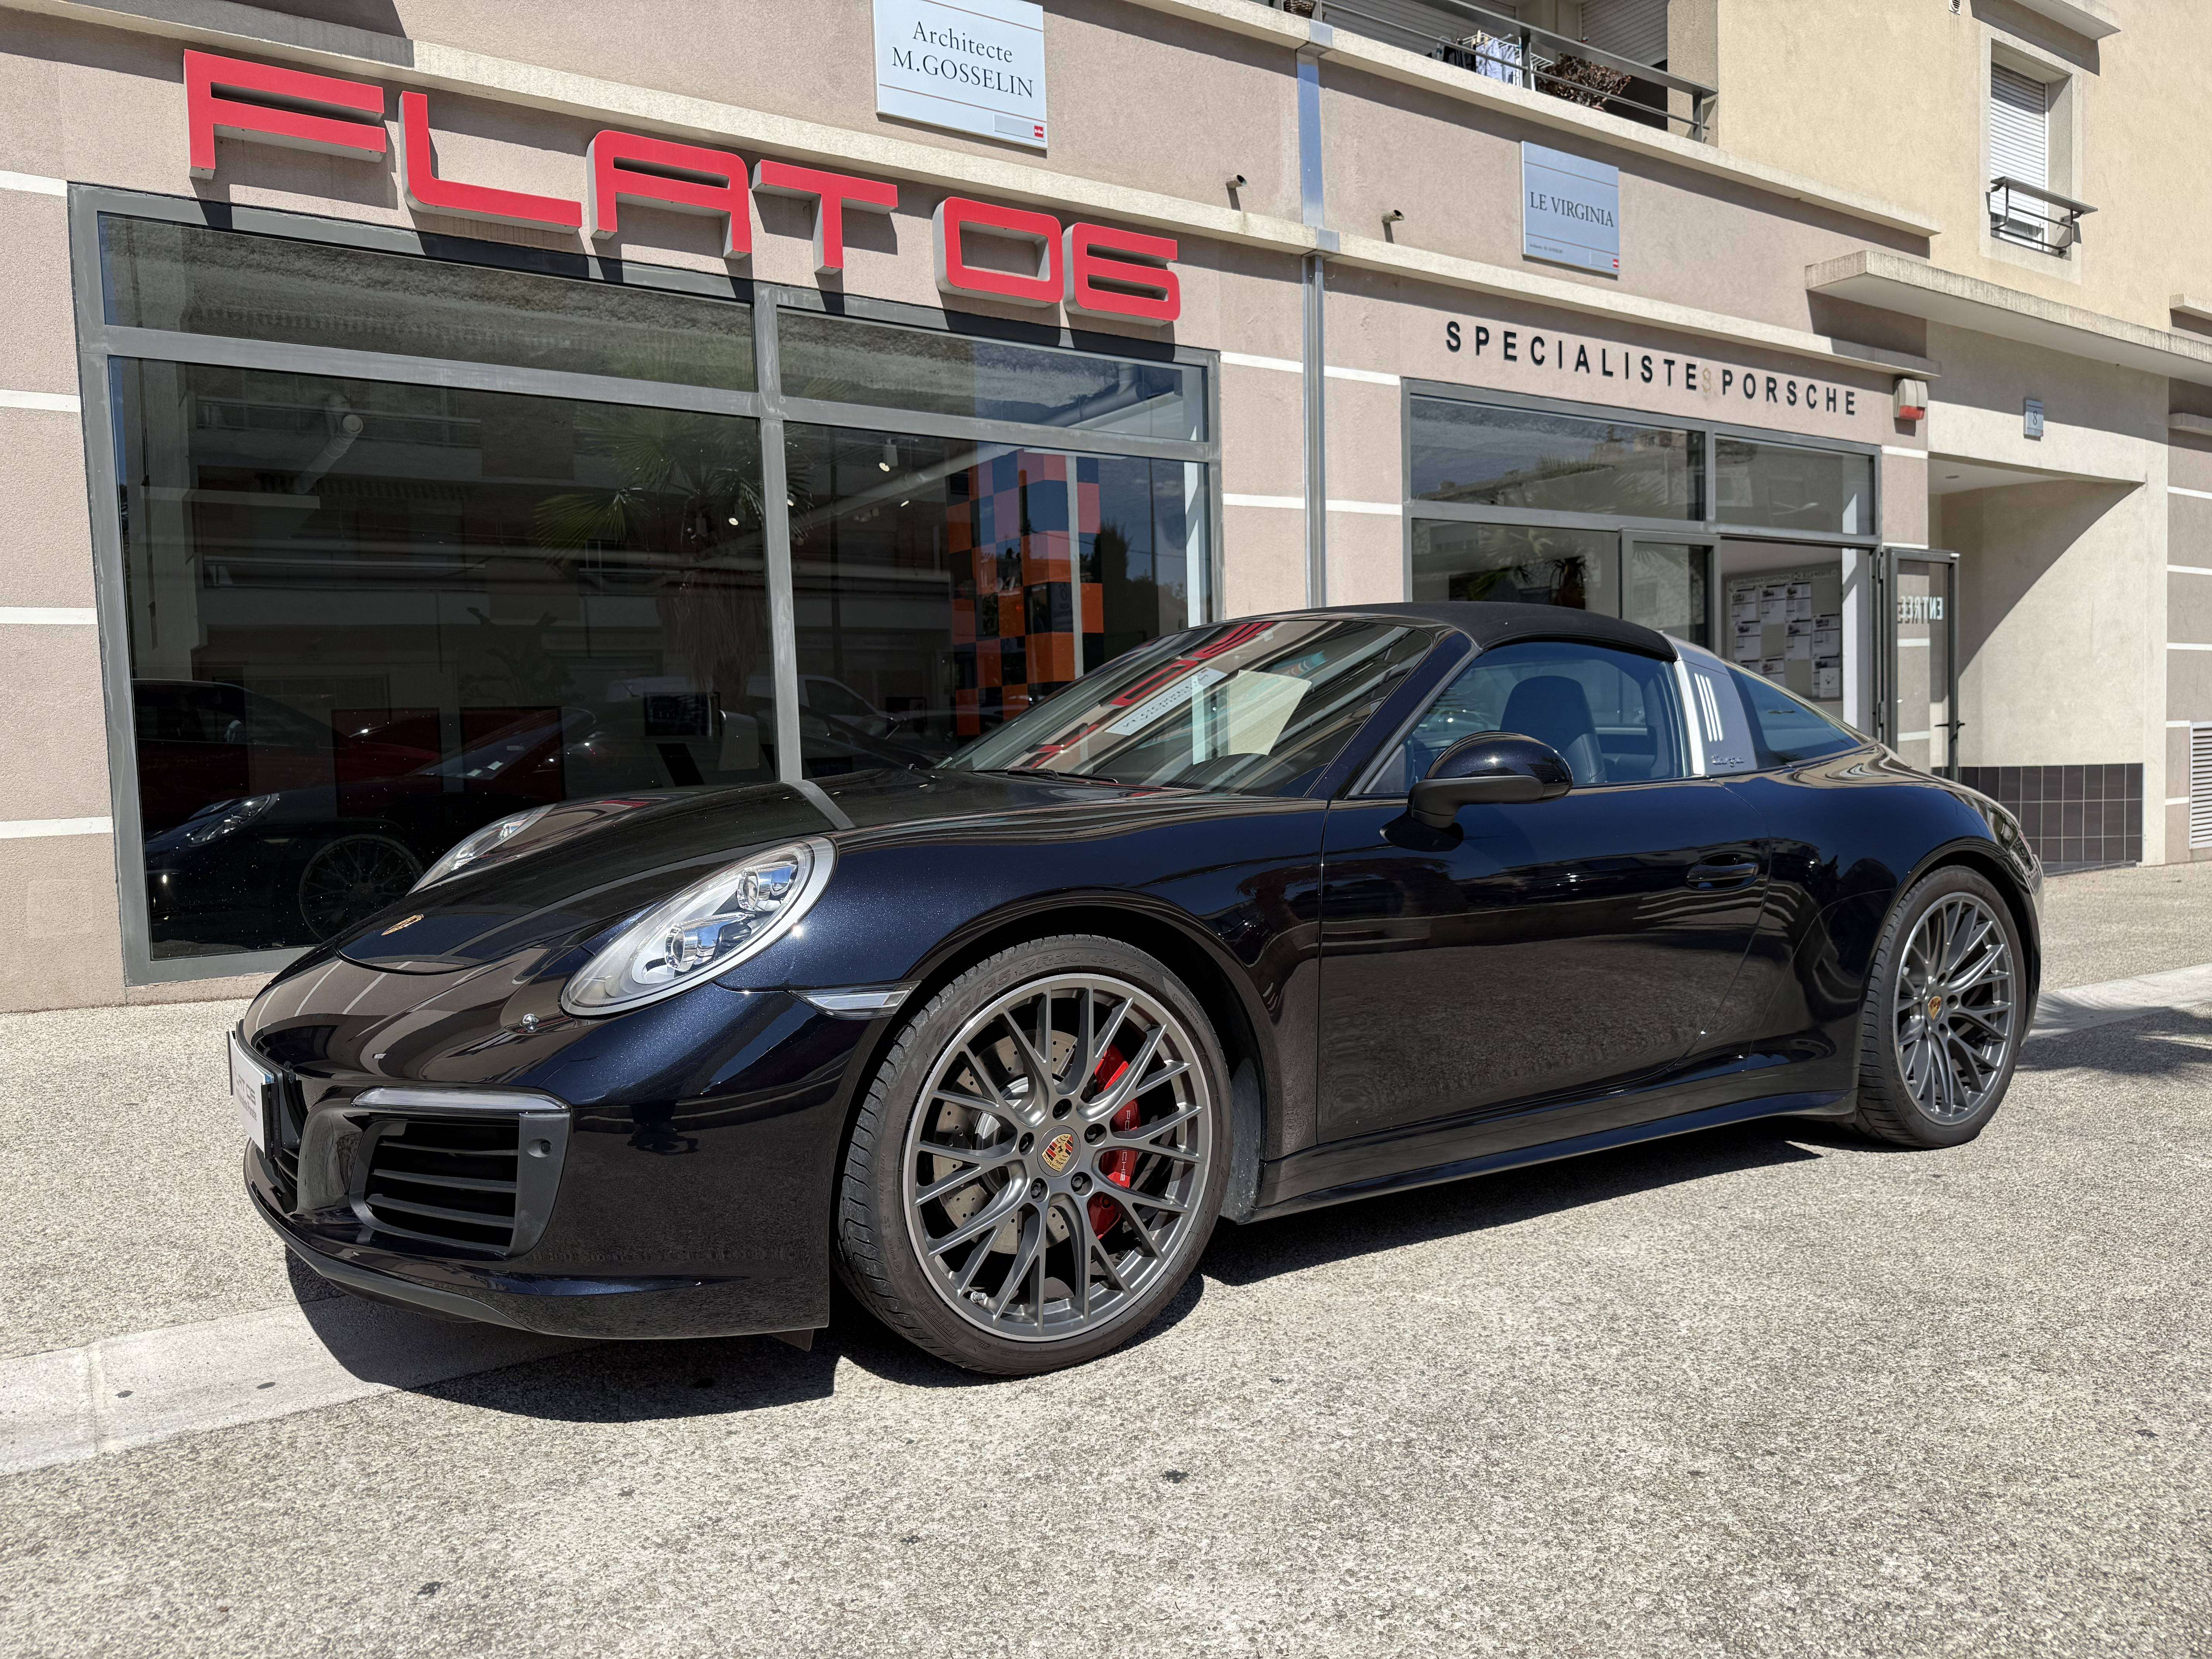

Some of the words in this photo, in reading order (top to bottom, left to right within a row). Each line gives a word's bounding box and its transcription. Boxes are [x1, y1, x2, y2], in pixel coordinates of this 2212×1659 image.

[912, 21, 1013, 63] Architecte
[891, 46, 1033, 98] M.GOSSELIN
[183, 49, 898, 274] FLAT
[934, 197, 1180, 326] 06
[1530, 192, 1547, 211] LE
[1551, 197, 1614, 227] VIRGINIA
[1446, 321, 1697, 391] SPECIALISTE
[1722, 369, 1855, 416] PORSCHE
[2033, 410, 2038, 425] 8
[934, 969, 1012, 1046] 245/35
[1018, 951, 1084, 975] ZR20
[1120, 1110, 1131, 1181] POCHE
[914, 1297, 965, 1345] PIRELLI
